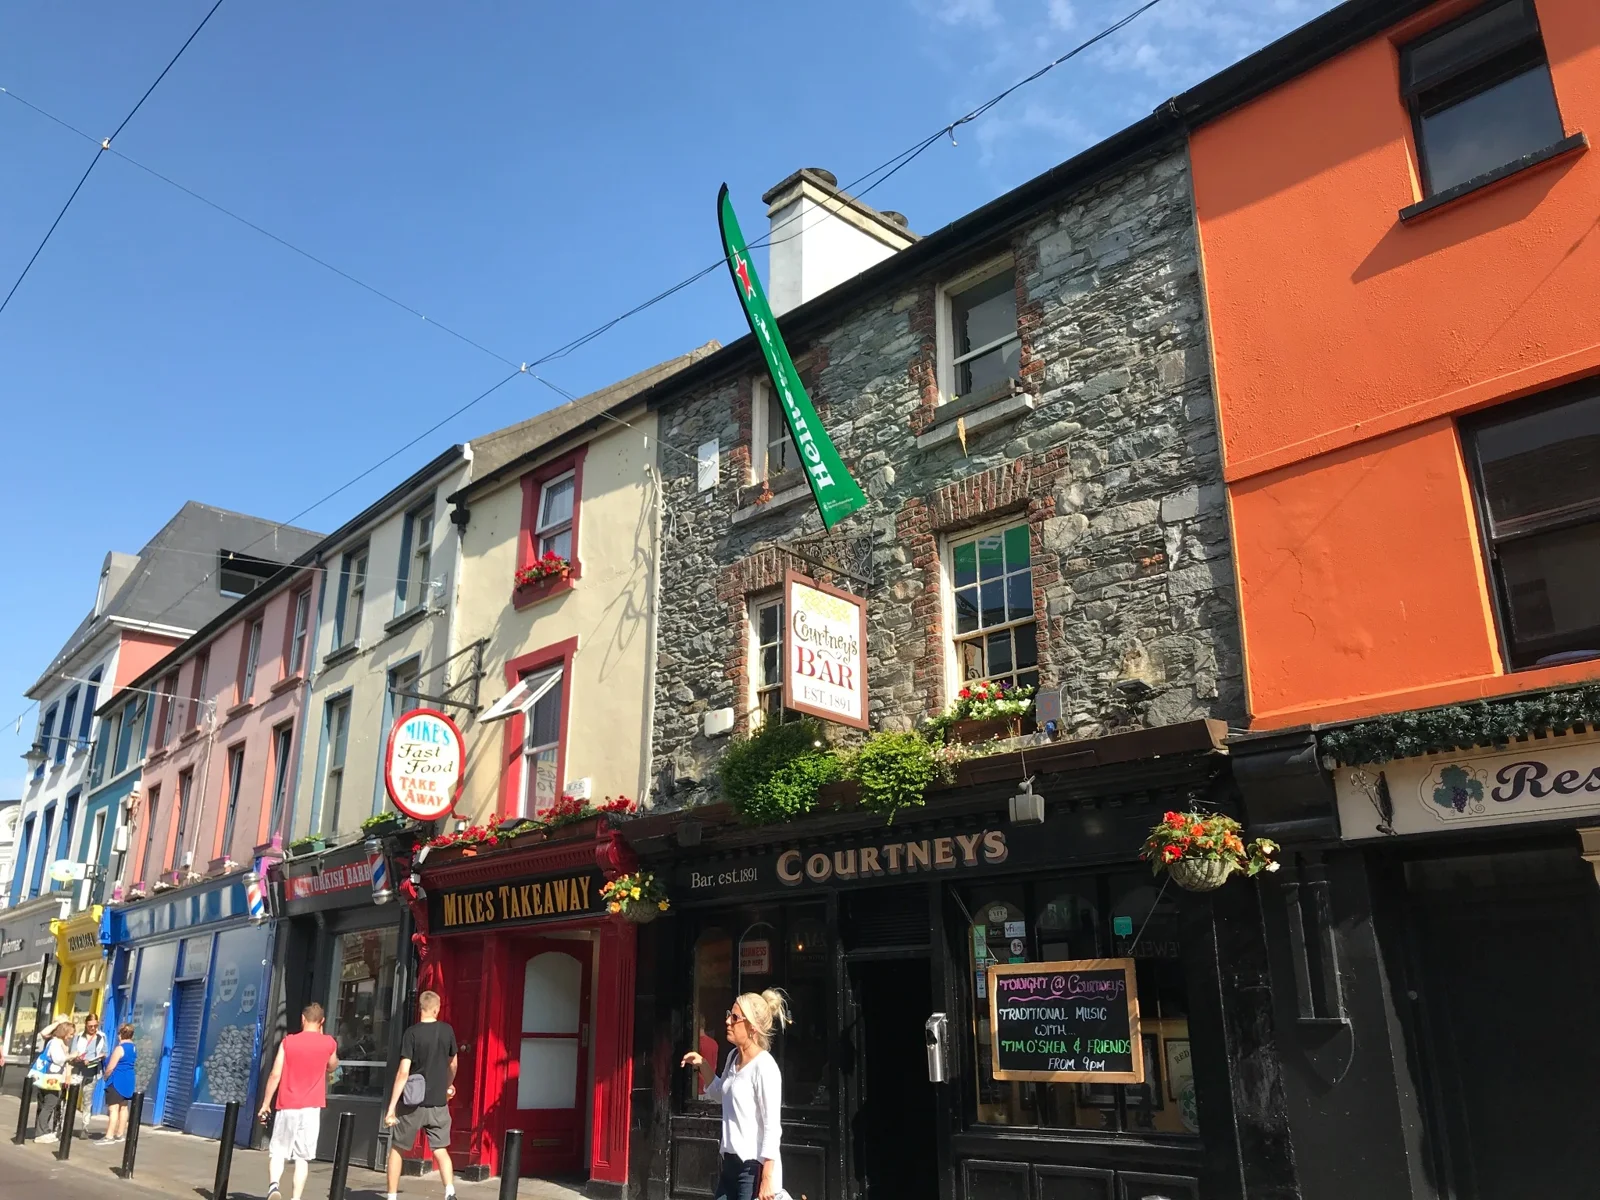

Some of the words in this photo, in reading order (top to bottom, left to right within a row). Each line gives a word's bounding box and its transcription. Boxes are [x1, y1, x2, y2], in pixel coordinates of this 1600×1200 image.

[792, 610, 858, 664] Courtney's
[795, 645, 854, 691] BAR
[803, 686, 828, 704] EST.
[829, 693, 851, 711] 1891
[406, 721, 451, 745] MIKE'S
[397, 743, 440, 758] Fast
[404, 759, 454, 774] Food
[400, 776, 437, 791] TAKE
[404, 789, 443, 806] AWAY
[310, 869, 345, 892] TURKISH
[443, 890, 495, 926] MIKES
[499, 876, 591, 919] TAKEAWAY
[999, 975, 1048, 993] TONIGHT
[1050, 975, 1065, 995] @
[999, 1007, 1068, 1020] TRADITIONAL
[1075, 1006, 1107, 1022] MUSIC
[1001, 1040, 1025, 1053] TIM
[1026, 1039, 1067, 1054] O'SHEA
[1073, 1037, 1081, 1054] &
[1087, 1038, 1131, 1054] FRIENDS
[1048, 1057, 1075, 1070] FROM
